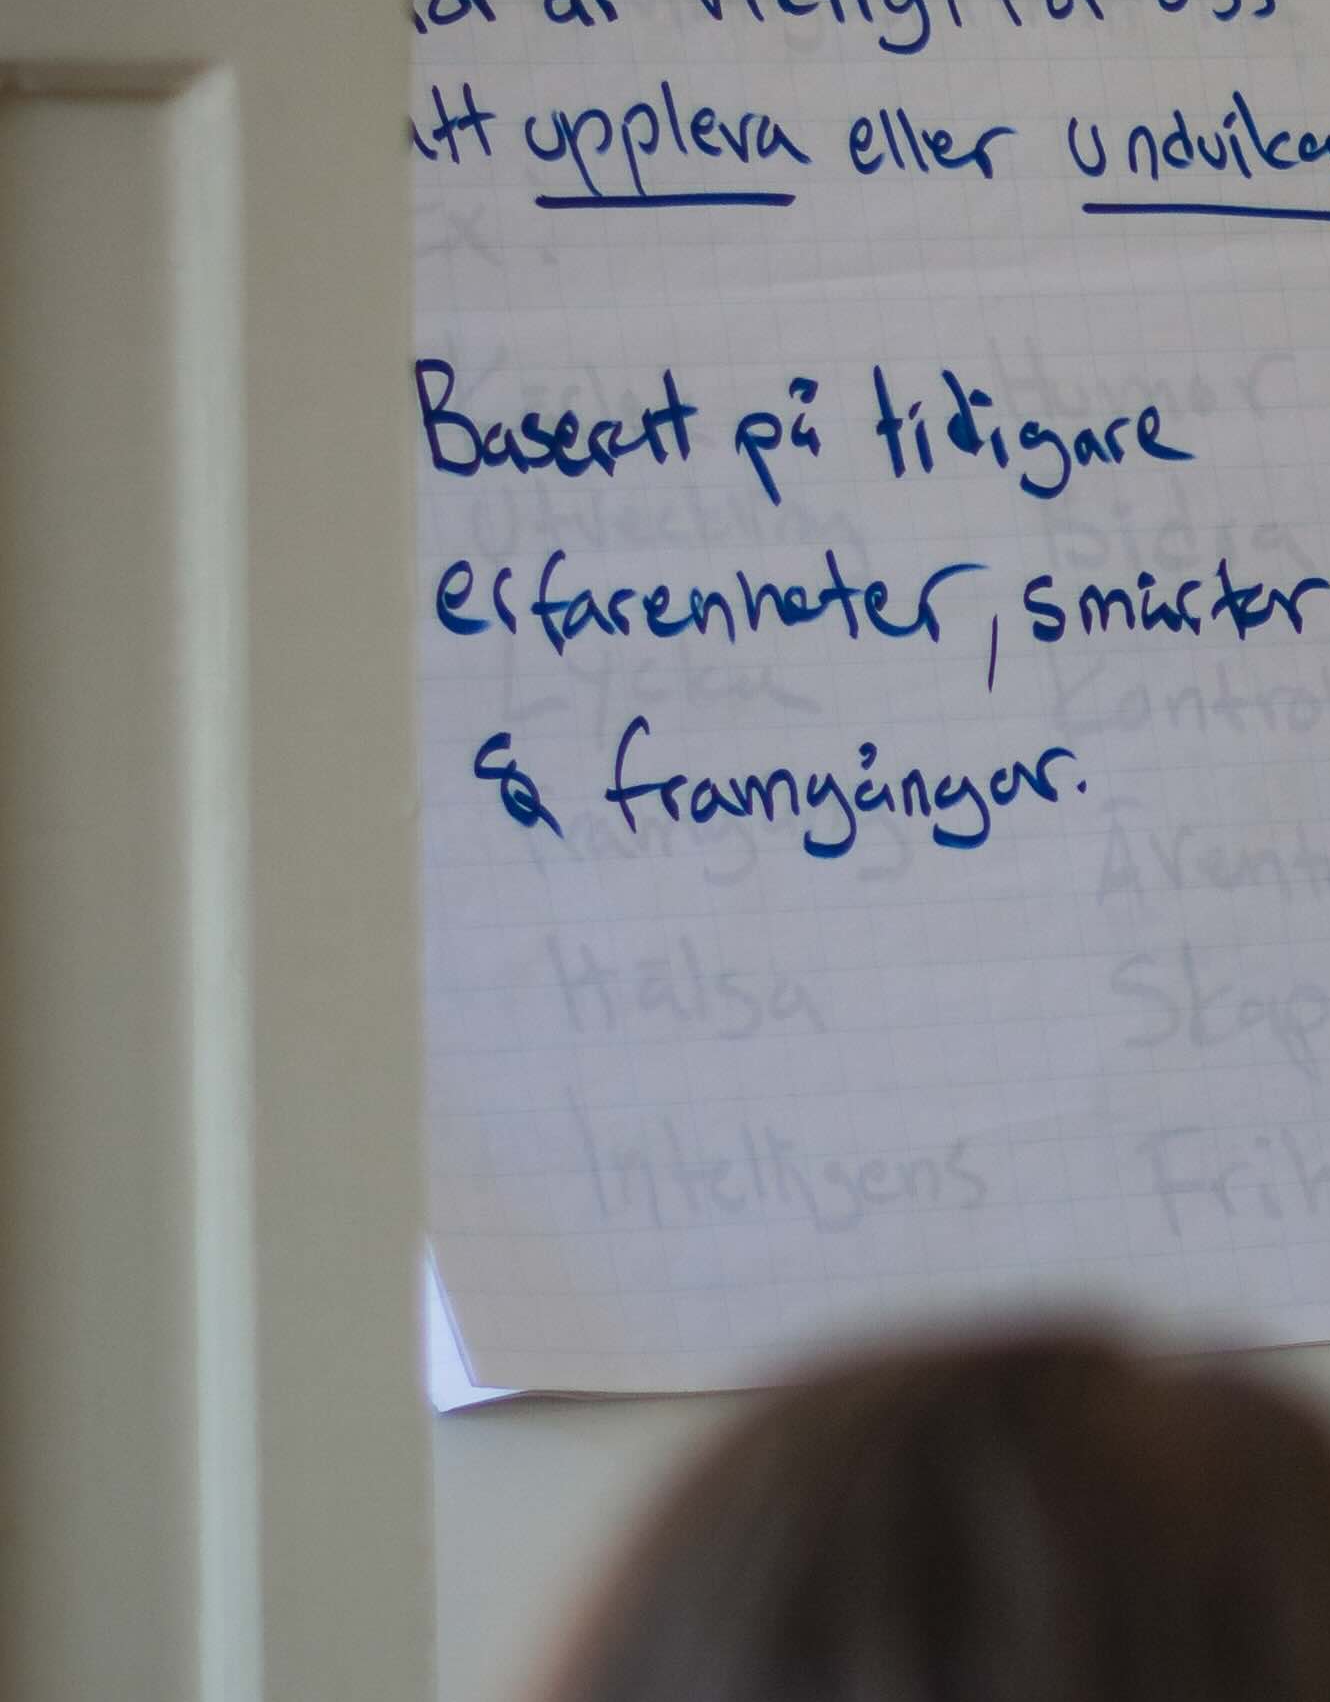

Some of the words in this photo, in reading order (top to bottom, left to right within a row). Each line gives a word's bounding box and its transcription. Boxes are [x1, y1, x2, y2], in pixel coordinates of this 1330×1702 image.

[523, 80, 812, 200] uppleva
[848, 108, 1018, 180] eller
[733, 376, 821, 506] på
[872, 364, 1196, 500] tidigare
